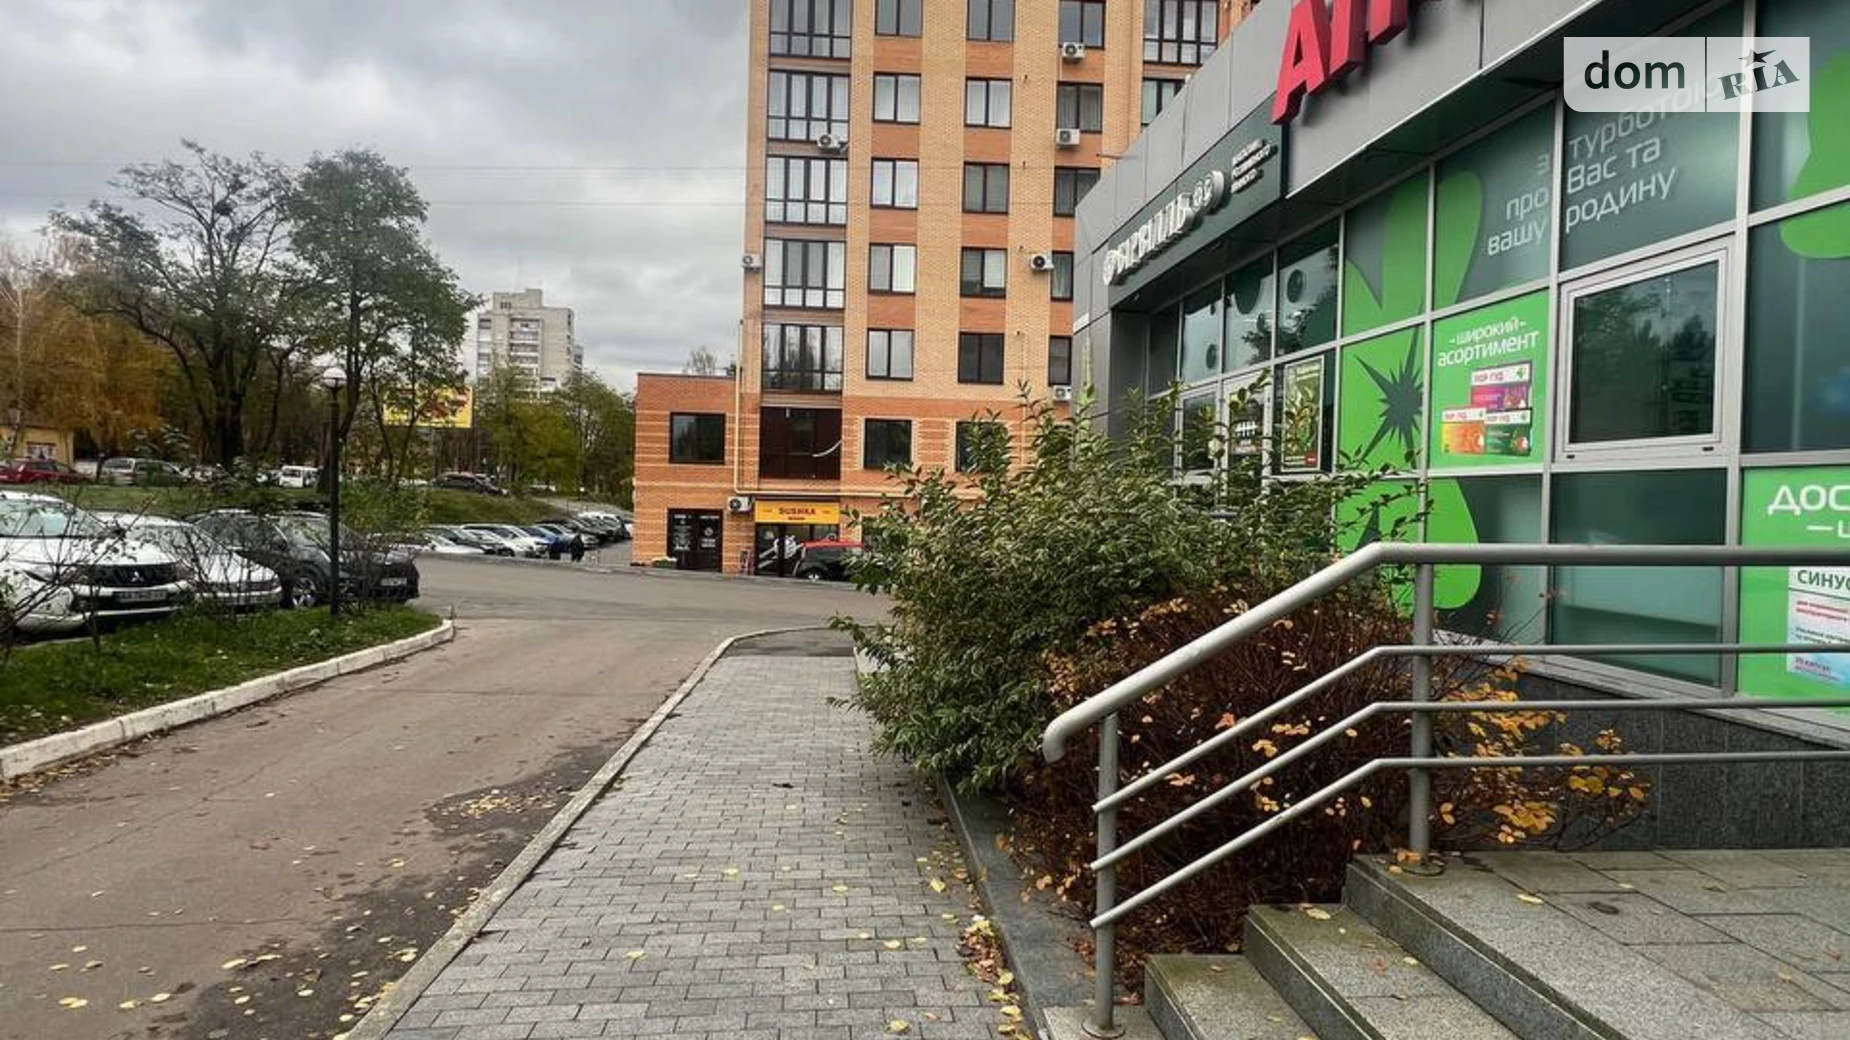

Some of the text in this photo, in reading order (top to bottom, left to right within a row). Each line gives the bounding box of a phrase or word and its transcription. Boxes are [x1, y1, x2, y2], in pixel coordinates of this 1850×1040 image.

[1487, 167, 1676, 256] вашу родину
[1506, 137, 1661, 221] про Вас та
[1437, 331, 1540, 367] асортимент
